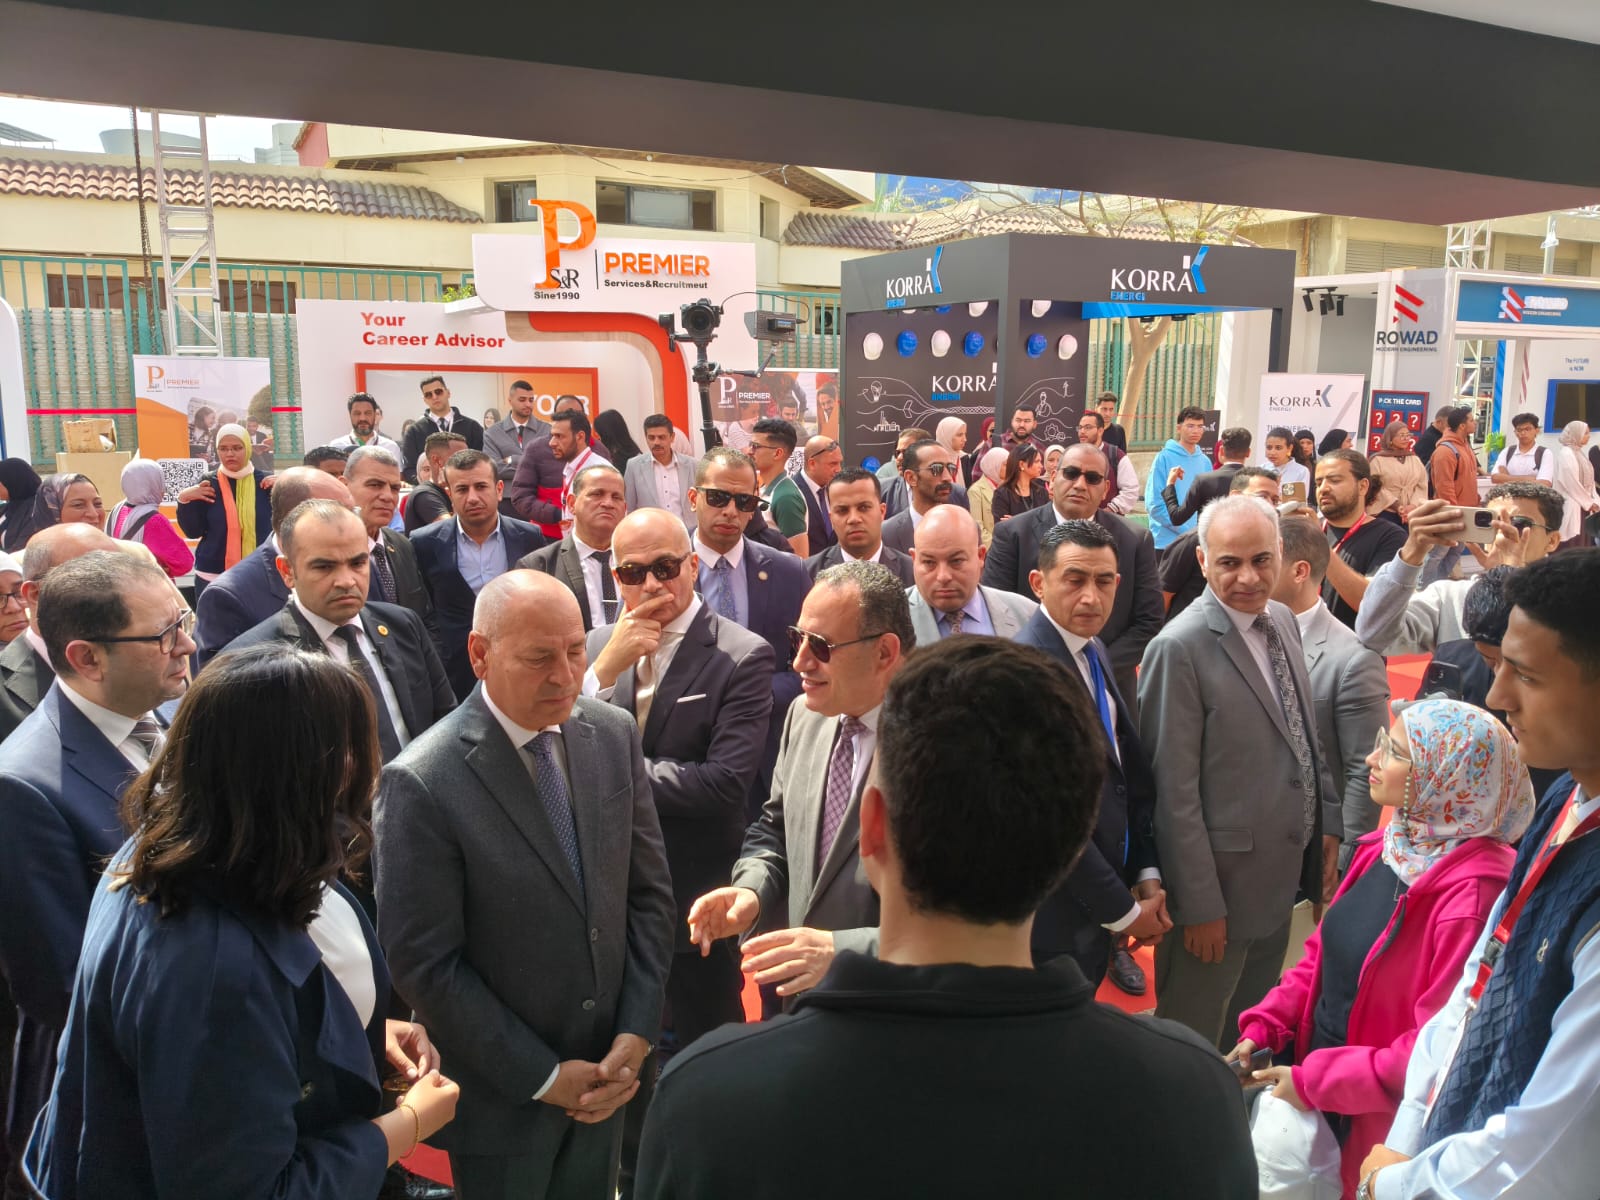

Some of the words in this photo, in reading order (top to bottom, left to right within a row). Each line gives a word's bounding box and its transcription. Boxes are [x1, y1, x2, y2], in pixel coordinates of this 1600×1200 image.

[603, 252, 711, 277] PREMIER
[550, 268, 580, 289] S&R
[886, 274, 933, 298] KORRA
[1111, 268, 1193, 293] KORRA
[360, 312, 406, 327] Your
[362, 331, 429, 346] Career
[434, 333, 506, 348] Advisor
[1376, 330, 1439, 345] ROWAD
[932, 375, 997, 392] KORRA
[738, 391, 771, 399] PREMIER
[1269, 396, 1322, 407] KORRA
